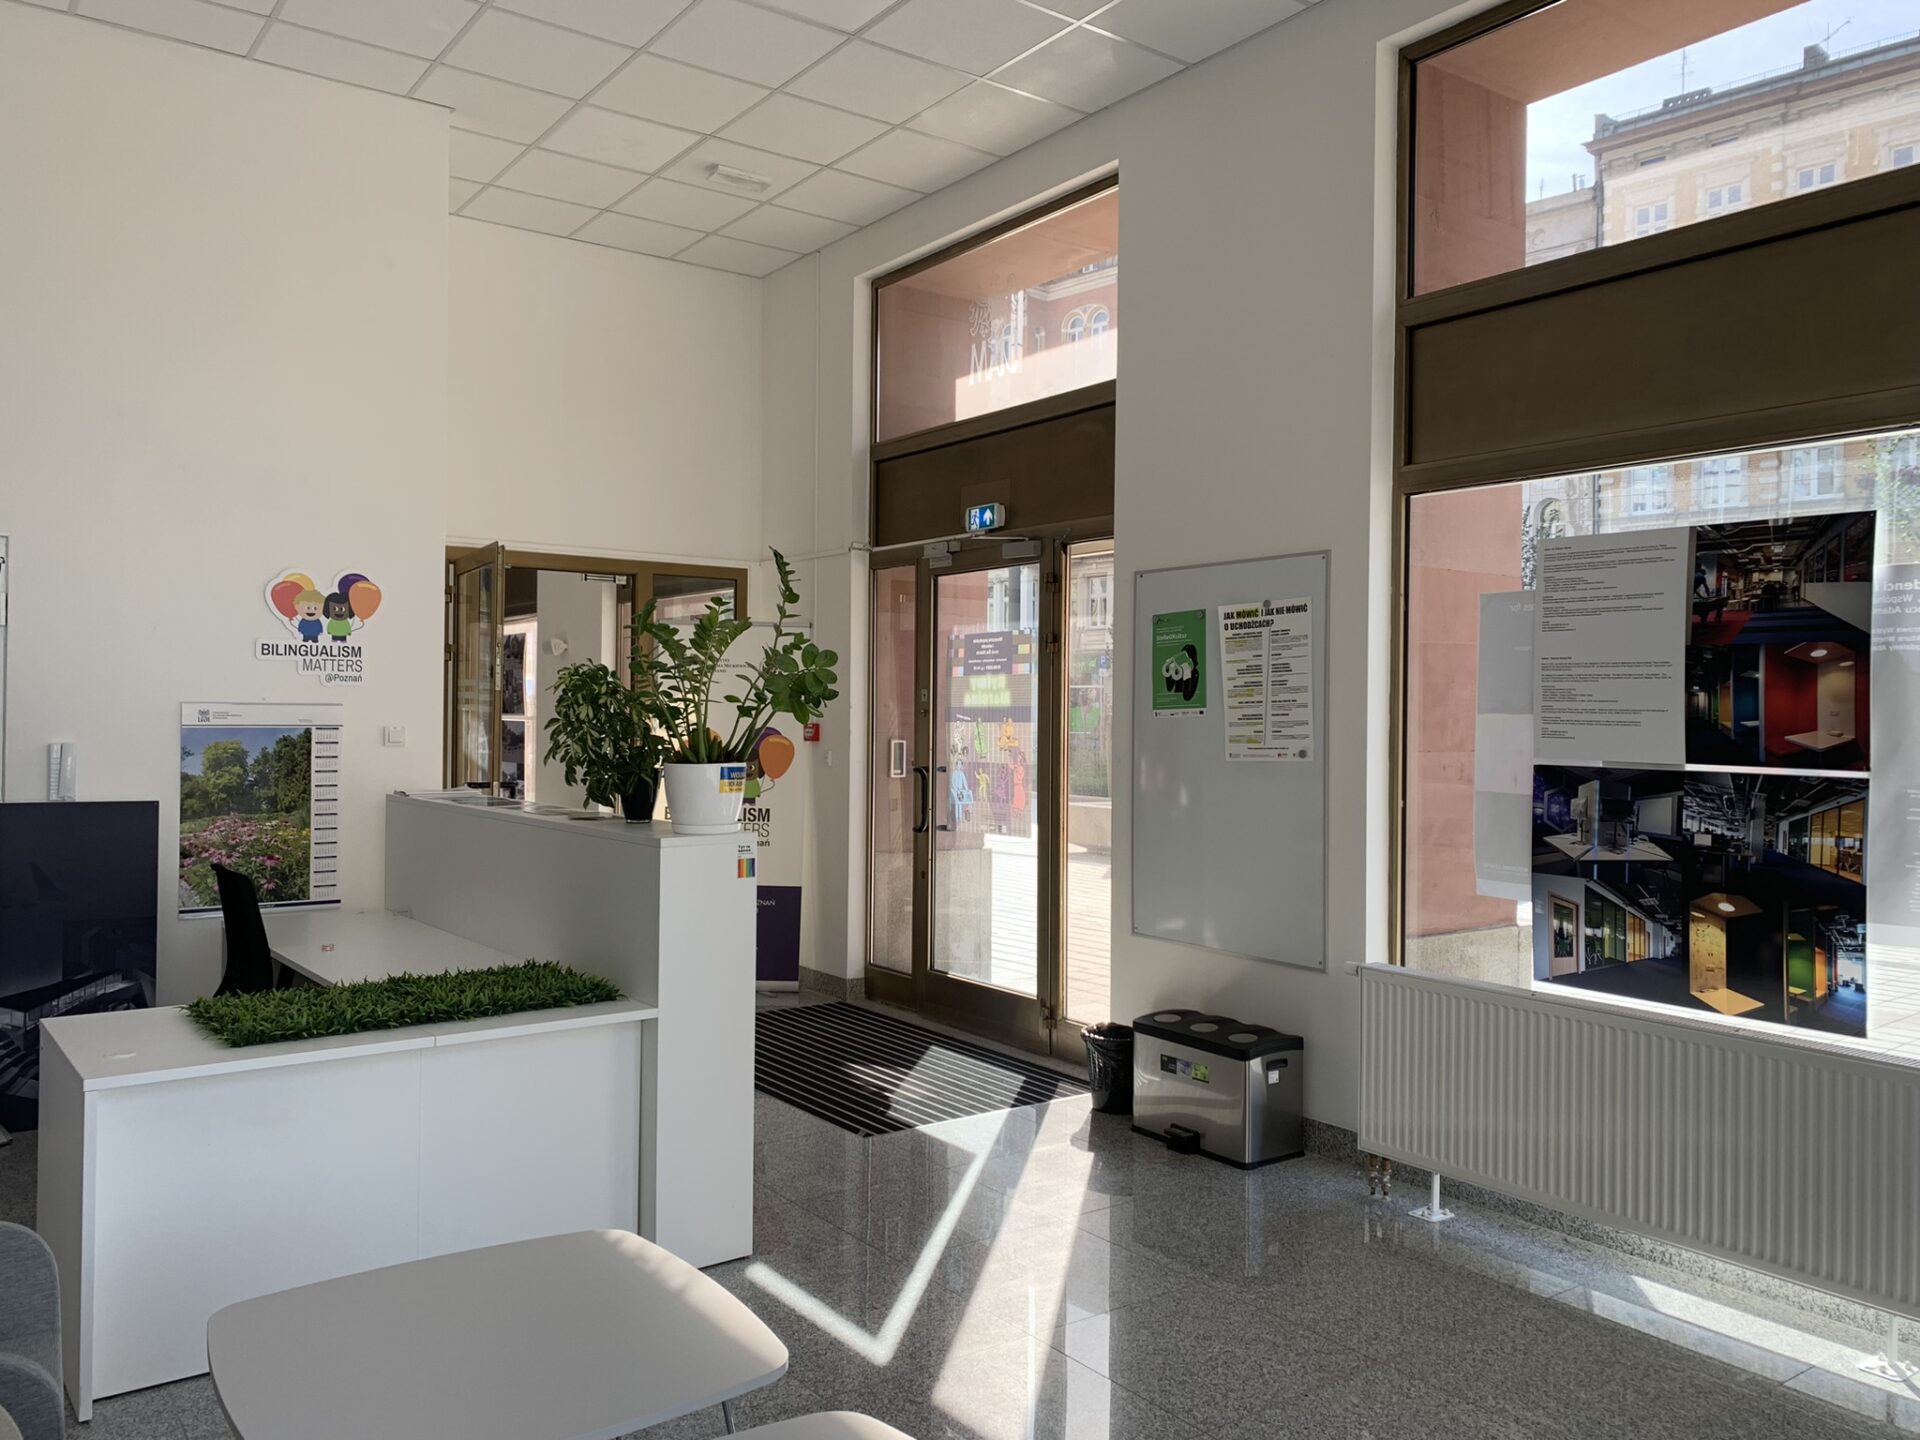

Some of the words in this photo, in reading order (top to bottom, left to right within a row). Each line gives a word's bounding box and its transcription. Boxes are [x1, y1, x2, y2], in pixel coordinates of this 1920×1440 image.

[1223, 611, 1235, 620] JAK
[1236, 608, 1259, 619] MÓWIĆ
[1264, 608, 1275, 617] JAK
[1275, 606, 1285, 615] NIE
[1286, 602, 1308, 614] MÓWIĆ
[1224, 623, 1229, 631] O
[260, 643, 363, 658] BILINGUALISM
[302, 658, 364, 673] MATTERS
[324, 673, 363, 684] @Poznań
[738, 808, 771, 822] ISM
[741, 822, 770, 838] ERS
